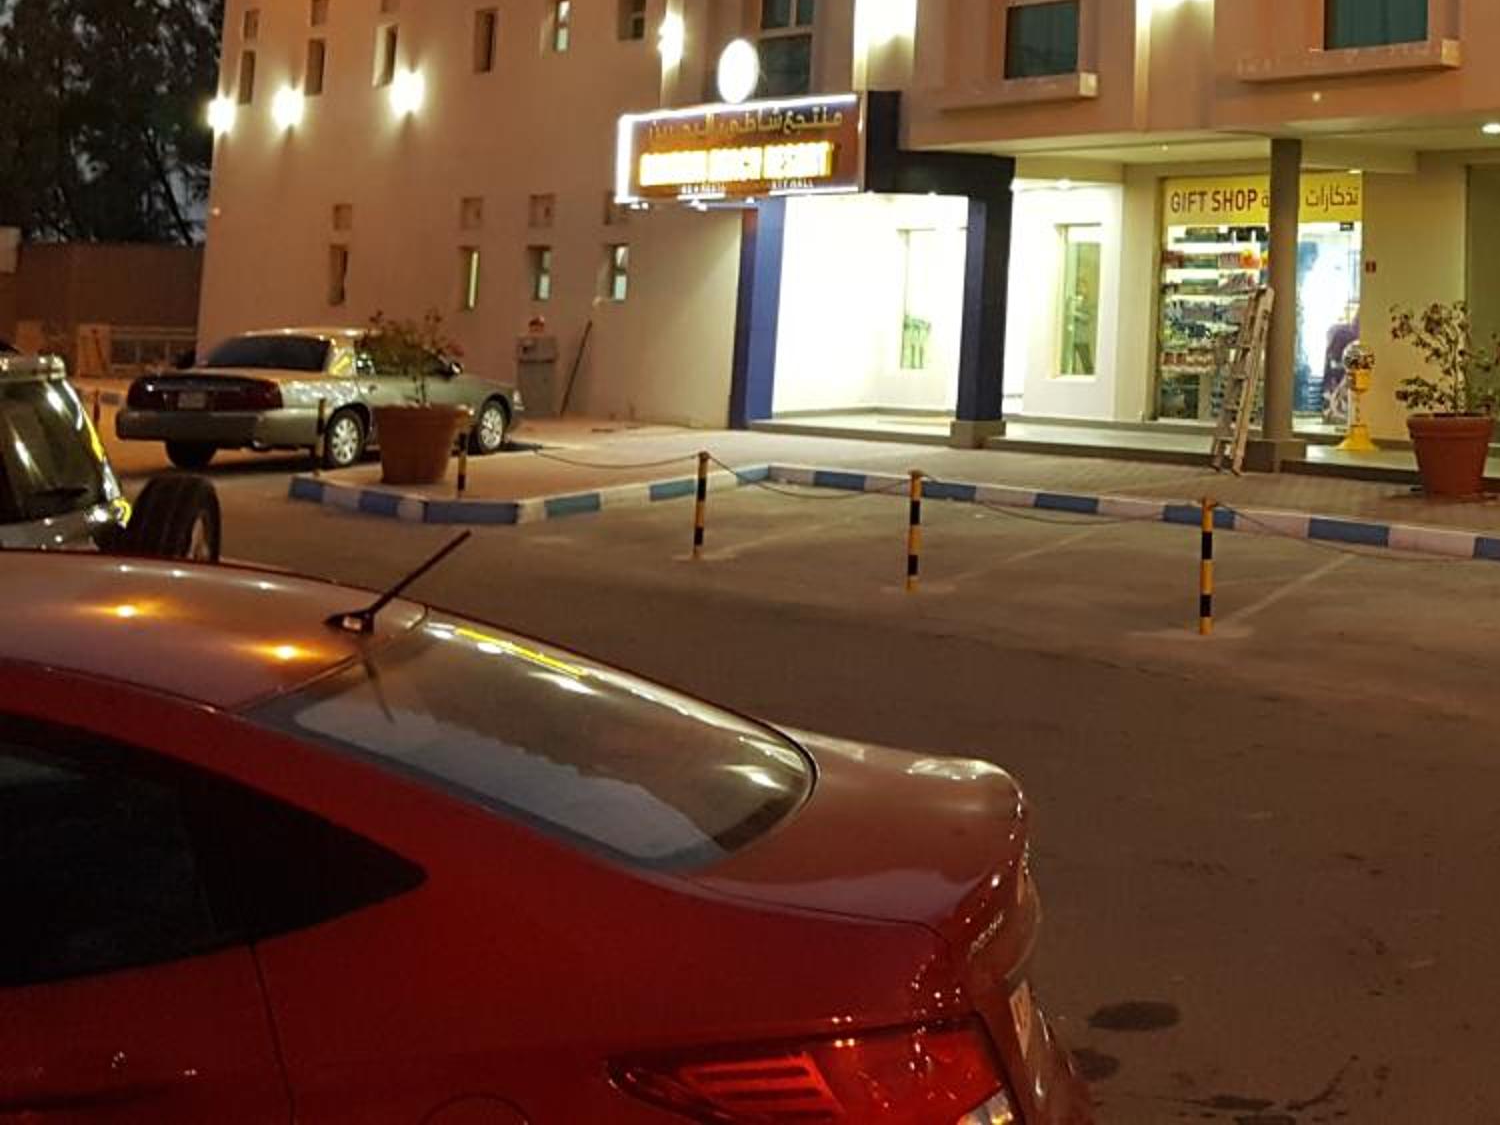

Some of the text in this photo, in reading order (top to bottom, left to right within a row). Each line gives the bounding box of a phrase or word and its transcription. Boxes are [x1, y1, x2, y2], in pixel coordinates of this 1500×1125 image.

[1171, 190, 1207, 213] GIFT
[1212, 188, 1258, 212] SHOP
[1305, 185, 1359, 212] تذكارات
